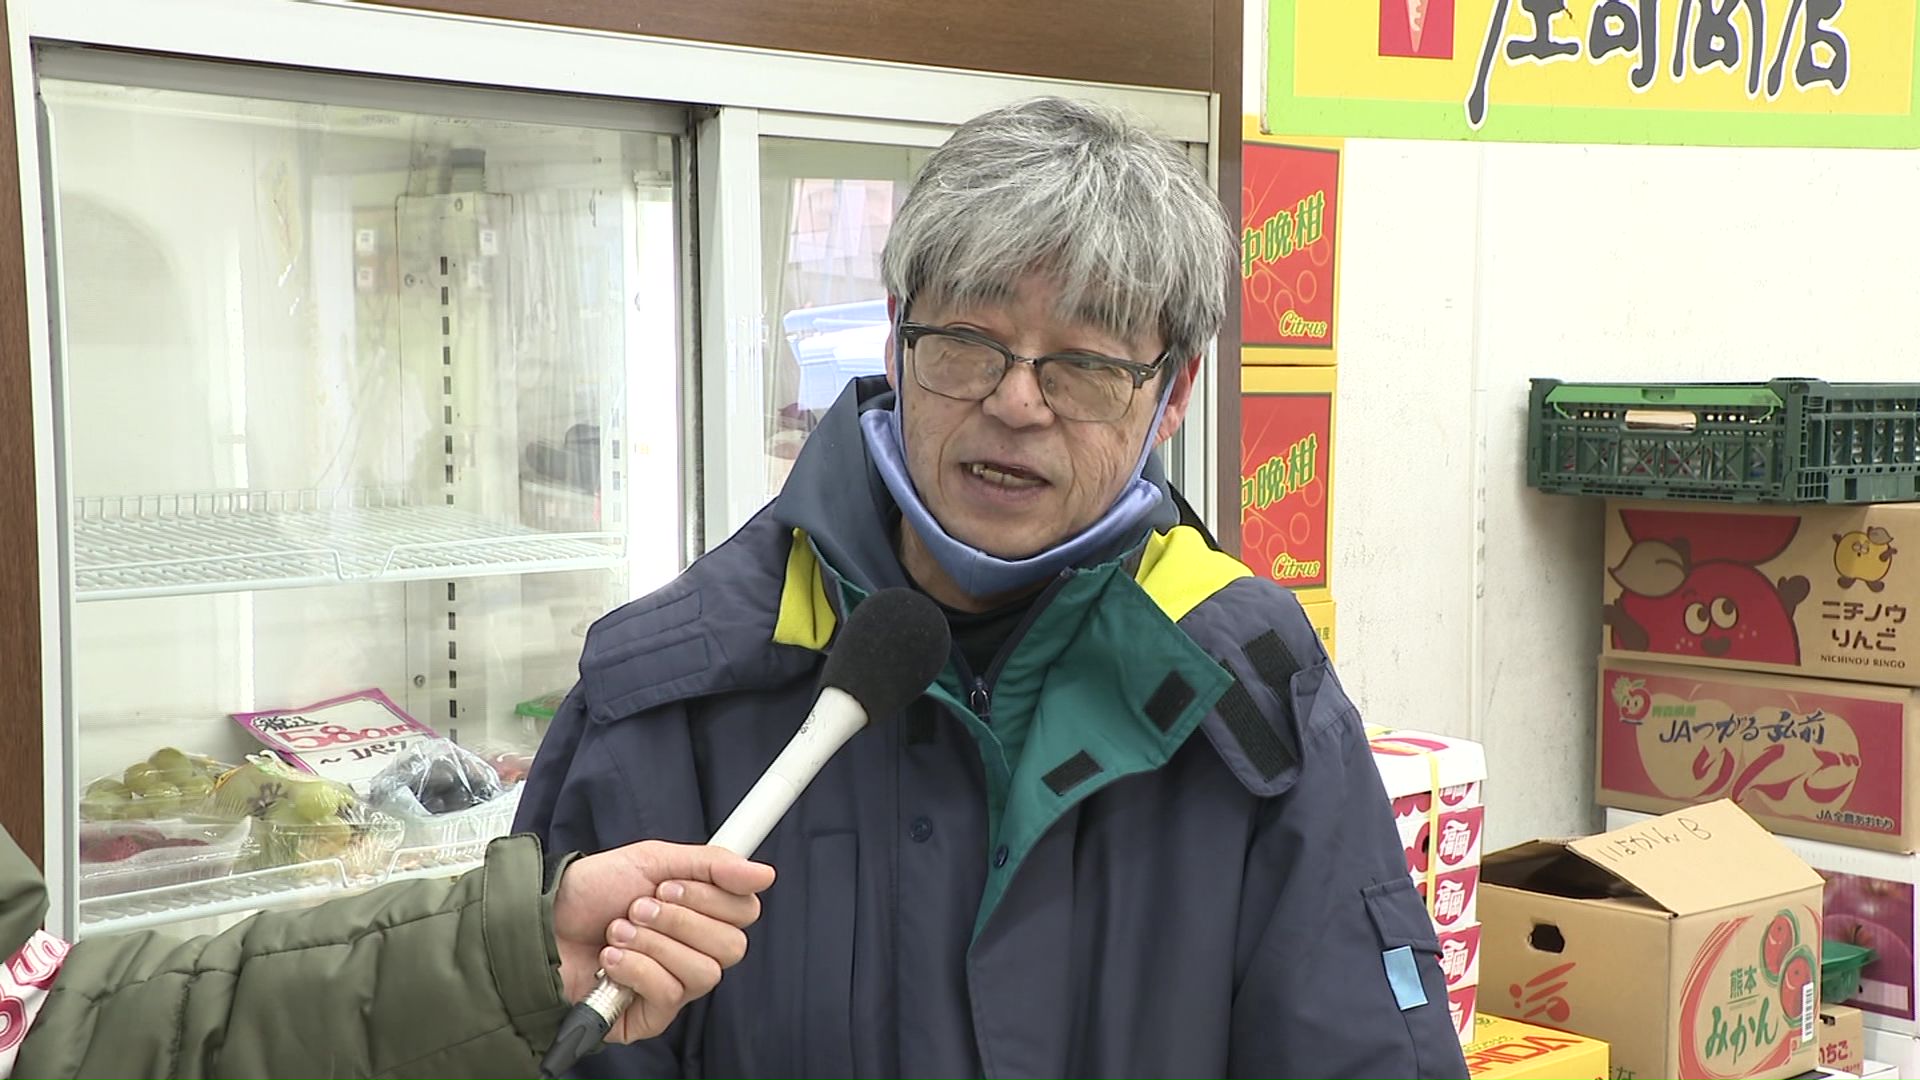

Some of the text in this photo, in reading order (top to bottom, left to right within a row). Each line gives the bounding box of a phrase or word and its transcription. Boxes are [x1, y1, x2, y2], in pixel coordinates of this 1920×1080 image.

[1279, 311, 1327, 338] Citrus
[1272, 553, 1320, 580] Citrus
[1822, 601, 1907, 624] ニチノウ
[1832, 628, 1896, 652] りんご
[1820, 655, 1906, 669] NICHINOU RINGO
[1659, 709, 1826, 745] JAつがる弘前
[1692, 743, 1861, 804] りんご
[1729, 965, 1757, 999] 熊本
[1705, 997, 1779, 1065] みかん
